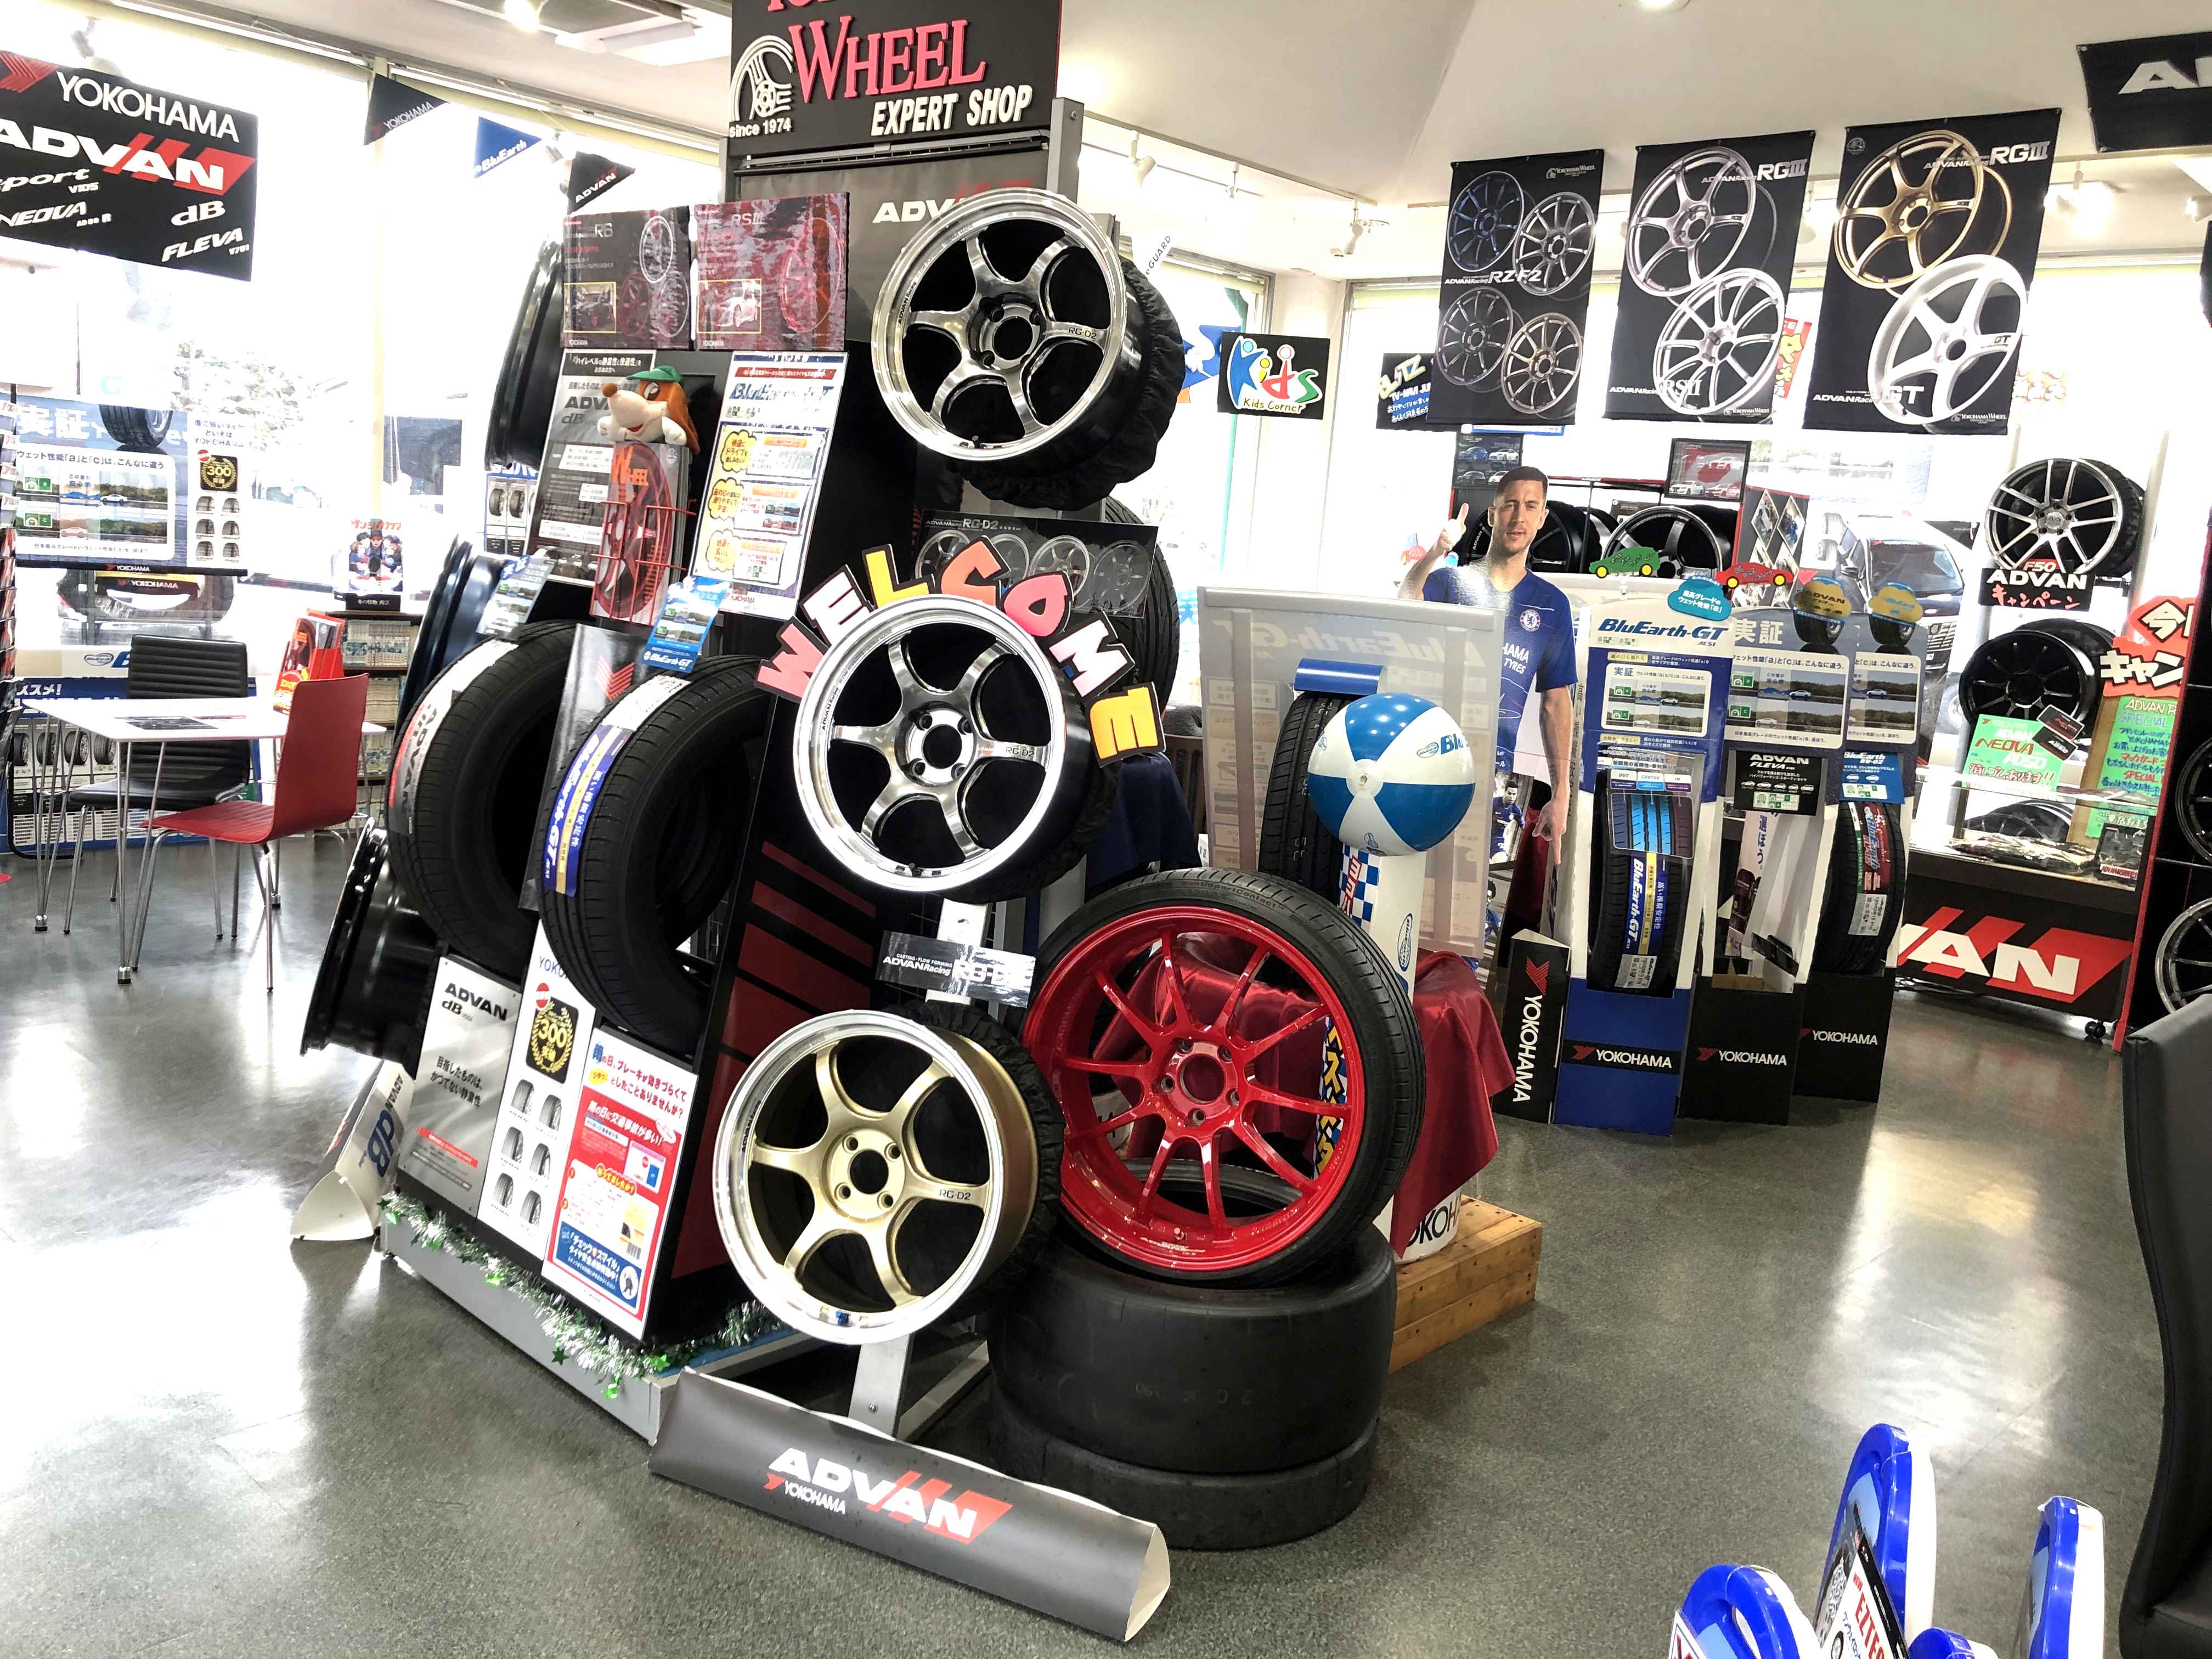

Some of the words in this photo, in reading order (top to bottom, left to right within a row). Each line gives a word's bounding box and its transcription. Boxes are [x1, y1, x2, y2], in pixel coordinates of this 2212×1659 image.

[788, 15, 986, 104] WHEEL
[56, 71, 240, 143] YOKOHAMA
[383, 101, 434, 130] YOKOHAMA
[871, 93, 959, 137] EXPERT
[966, 84, 1032, 126] SHOP
[729, 121, 760, 138] since
[763, 117, 792, 135] 1974
[0, 118, 224, 191] ADVAN
[481, 139, 527, 172] BluEarth
[574, 172, 617, 204] ADVAN
[171, 200, 226, 226] dB
[872, 198, 955, 223] ADV
[161, 228, 243, 262] FLEVA
[564, 396, 610, 410] ADV
[1243, 397, 1265, 410] Kids
[1267, 402, 1303, 413] Corner
[206, 466, 232, 477] 300
[131, 580, 179, 589] YOKOHAMA
[1986, 568, 2088, 590] ADVAN
[1991, 584, 2081, 609] キャンペーン
[1597, 618, 1729, 641] BluEarth-GT
[1734, 618, 1784, 645] 実証
[1503, 658, 1526, 675] TYRES
[1614, 667, 1634, 677] 実証
[2124, 698, 2165, 714] ADVAN
[1974, 737, 2034, 755] NEOVA
[1750, 753, 1809, 765] ADVAN
[1628, 857, 1644, 943] BluEarth-GT
[441, 1000, 462, 1016] dB
[444, 982, 509, 1021] ADVAN
[538, 1019, 567, 1048] 300
[1812, 1030, 1878, 1046] YOKOHAMA
[1512, 994, 1544, 1102] YOKOHAMA
[1595, 1048, 1673, 1070] YOKOHAMA
[1718, 1049, 1788, 1067] YOKOHAMA
[385, 1073, 404, 1111] ADVAN
[367, 1109, 395, 1177] dB
[768, 1447, 978, 1539] ADVAN
[784, 1479, 847, 1516] YOKOHAMA
